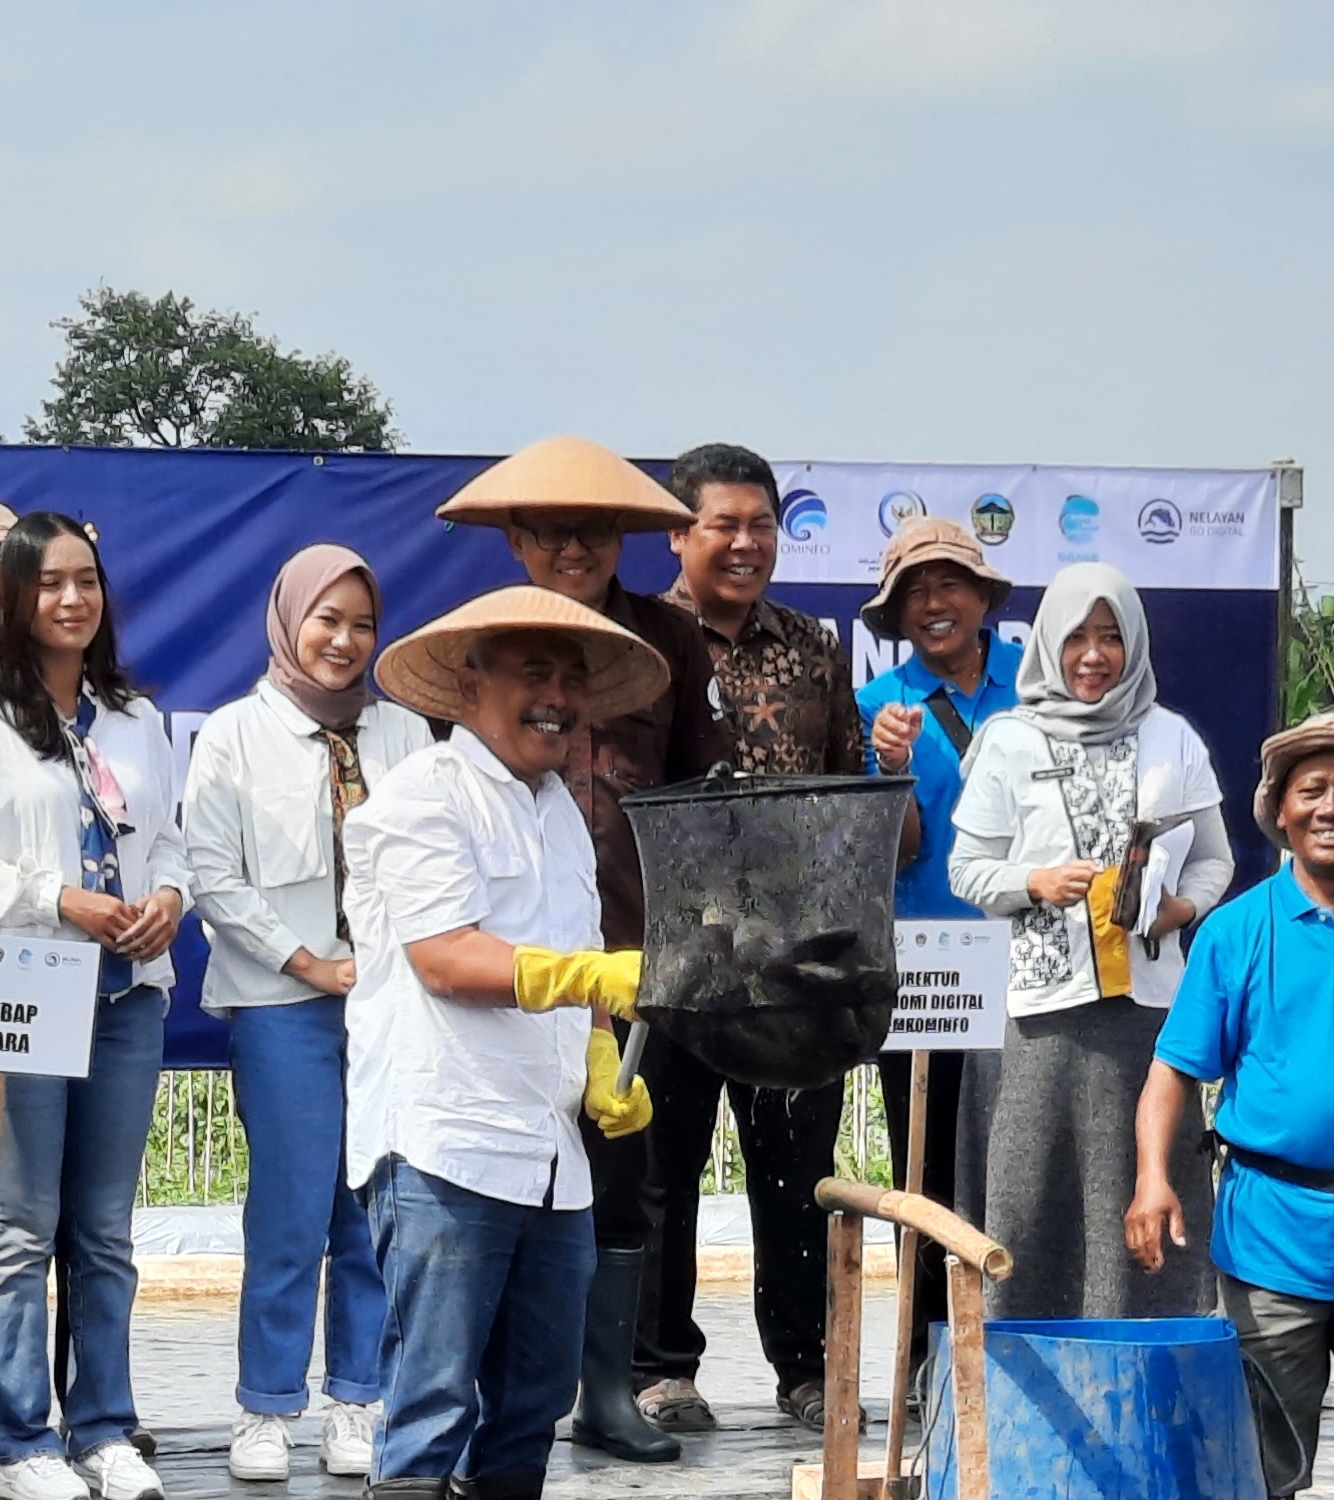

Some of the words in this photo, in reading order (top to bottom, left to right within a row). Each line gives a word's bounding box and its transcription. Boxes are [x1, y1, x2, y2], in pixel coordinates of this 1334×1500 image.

[1189, 511, 1245, 524] NELAYAN
[780, 543, 831, 555] OMINFO
[898, 970, 960, 987] IREKTUR
[930, 993, 985, 1011] DIGITAL
